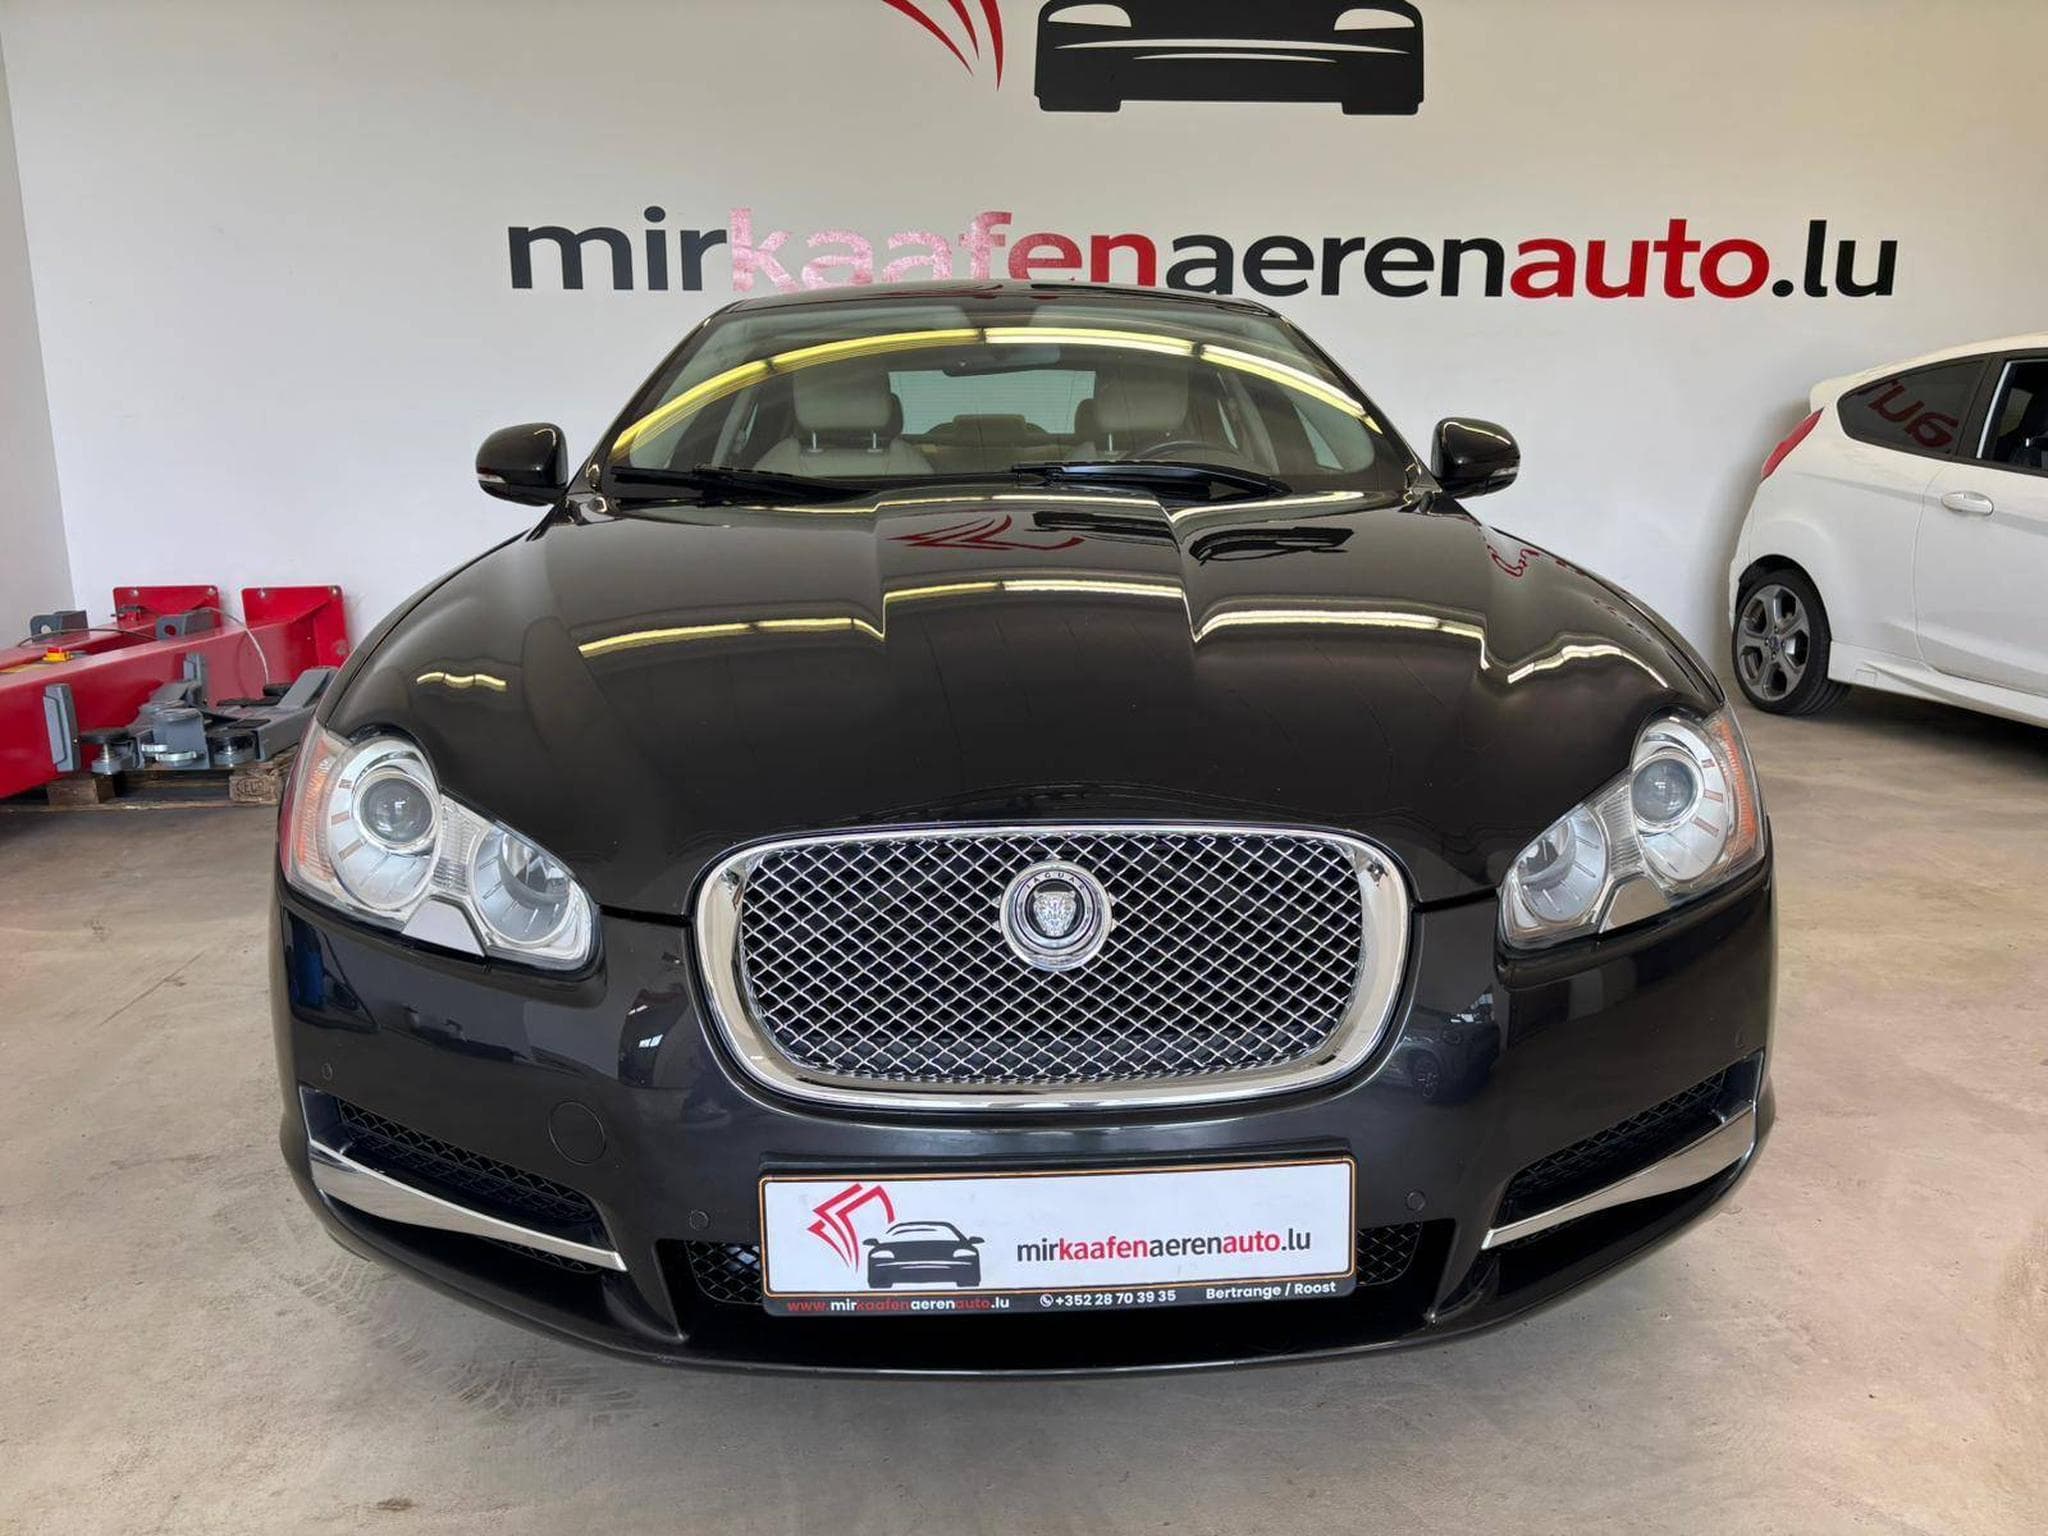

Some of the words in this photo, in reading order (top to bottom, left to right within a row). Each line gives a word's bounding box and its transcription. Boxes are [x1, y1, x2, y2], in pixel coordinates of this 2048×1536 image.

[507, 205, 1898, 299] mirkaafenaerenauto.lu
[1016, 1228, 1312, 1263] mirkaafenaerenauto.lu
[1055, 1293, 1092, 1307] +352
[1095, 1293, 1113, 1306] 28
[1116, 1292, 1133, 1305] 70
[1137, 1291, 1154, 1304] 39
[1158, 1290, 1177, 1302] 35
[1206, 1285, 1281, 1300] Bertrange
[1294, 1280, 1337, 1295] Roost
[787, 1296, 1010, 1312] www.mirkaafenaerenauto.lu
